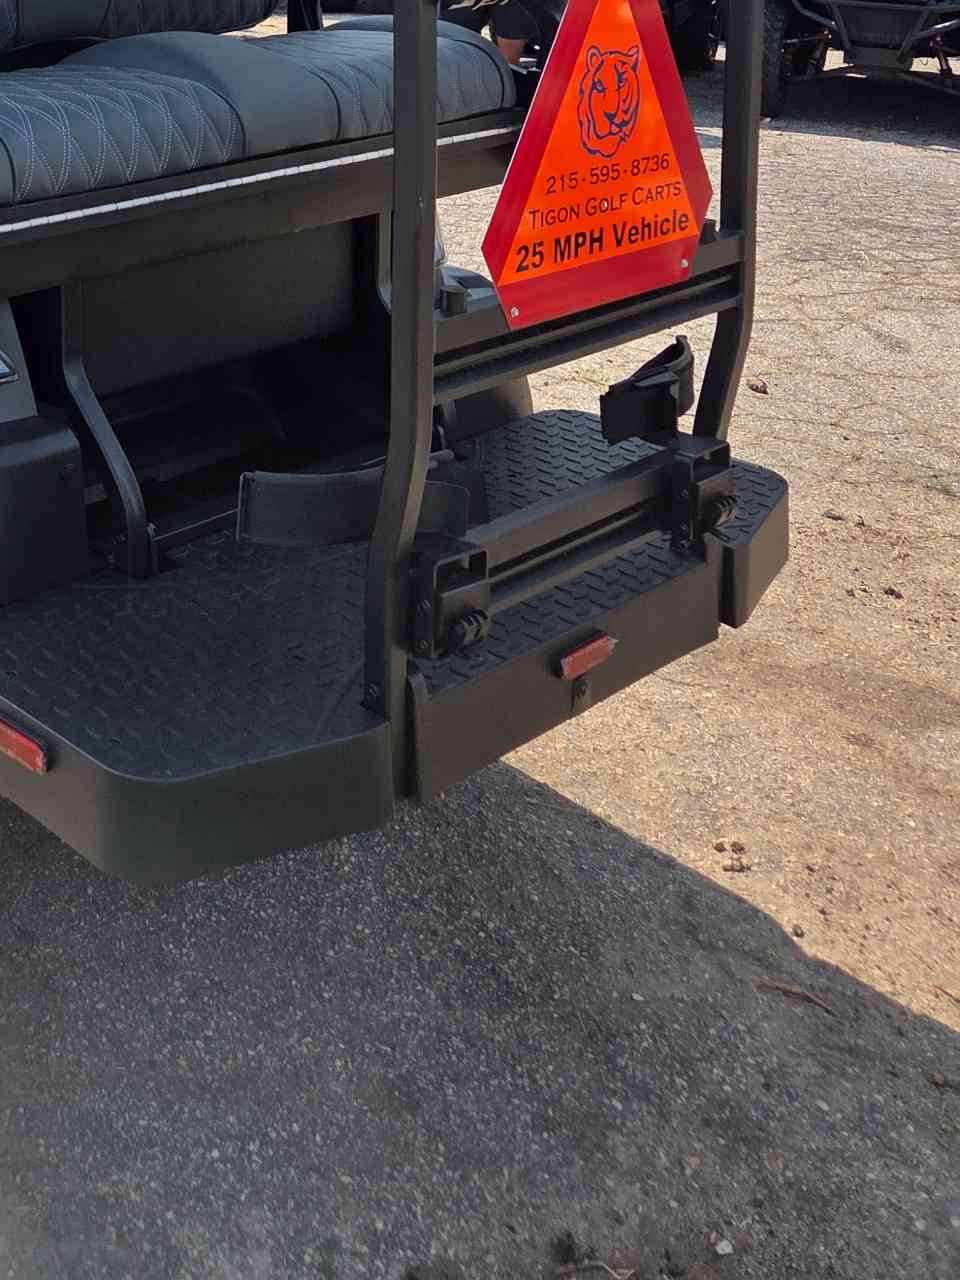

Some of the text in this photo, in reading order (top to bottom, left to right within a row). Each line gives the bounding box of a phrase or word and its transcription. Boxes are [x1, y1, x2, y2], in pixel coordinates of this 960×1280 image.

[528, 181, 682, 230] TIGON GOLF CARTS
[515, 209, 689, 273] 25 MPH Vehicle
